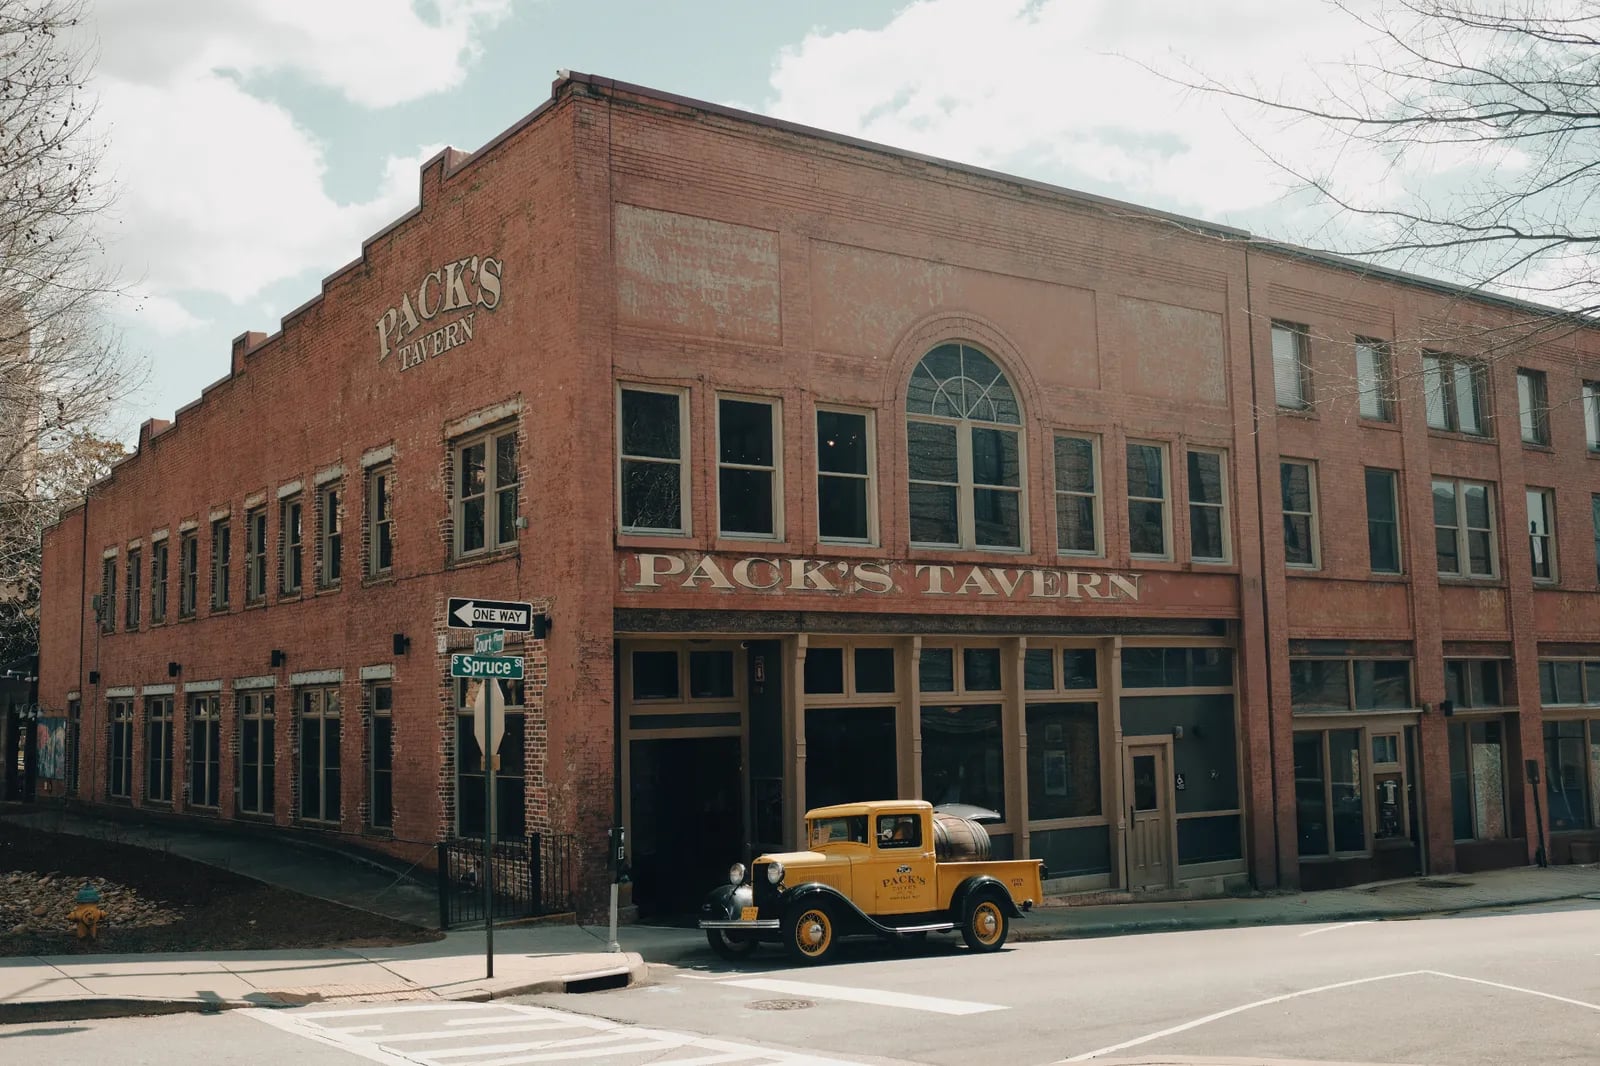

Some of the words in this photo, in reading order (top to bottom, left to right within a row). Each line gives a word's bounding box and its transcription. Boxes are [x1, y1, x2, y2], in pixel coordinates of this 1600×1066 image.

[375, 255, 504, 363] PACK'S
[397, 313, 475, 372] TAVERN
[634, 553, 894, 593] PACK'S
[915, 565, 1143, 601] TAVERN
[473, 609, 496, 620] ONE
[499, 610, 522, 622] WAY
[475, 635, 492, 653] Court
[453, 656, 459, 665] S
[462, 656, 511, 676] Spruce
[514, 658, 522, 667] St
[882, 875, 926, 888] PACK'S
